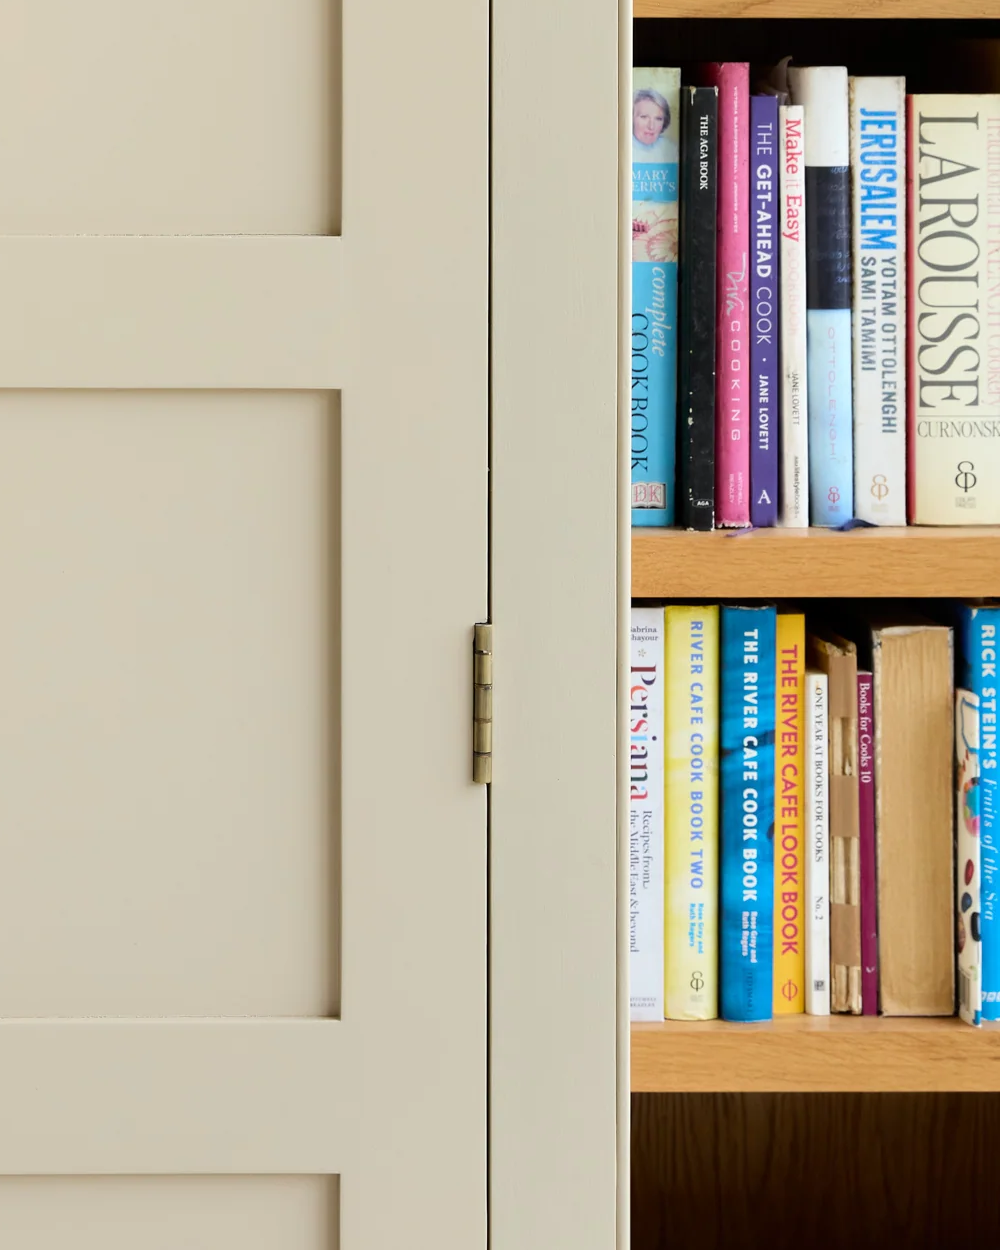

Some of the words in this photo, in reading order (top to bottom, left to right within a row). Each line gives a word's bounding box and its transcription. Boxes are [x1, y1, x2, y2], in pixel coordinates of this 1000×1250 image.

[700, 114, 708, 136] THE
[757, 122, 772, 156] THE
[785, 119, 802, 174] Make
[700, 138, 709, 160] AGA
[700, 161, 708, 190] BOOK
[860, 107, 898, 251] JERUSALEM
[756, 164, 772, 278] GET-AHEAD
[782, 195, 802, 243] Easy
[861, 256, 876, 300] SAMI
[917, 111, 980, 409] LAROUSSE
[881, 256, 897, 316] YOTAM
[645, 266, 672, 357] complete
[756, 286, 772, 344] COOK
[861, 307, 876, 371] TAMIMI
[632, 313, 649, 472] COOKBOOK
[731, 320, 741, 441] COOKING
[759, 375, 769, 403] JANE
[828, 327, 837, 460] OTTOLENGHI
[881, 322, 897, 434] OTTOLENGHI
[759, 407, 769, 450] LOVETT
[792, 394, 800, 425] LOVETT
[634, 484, 662, 503] DK
[690, 621, 704, 675] RIVER
[743, 628, 759, 664] THE
[781, 644, 798, 688] THE
[981, 624, 996, 677] RICK
[690, 682, 704, 725] CAFE
[743, 672, 759, 729] RIVER
[815, 687, 824, 710] ONE
[859, 682, 870, 714] Books
[631, 664, 657, 802] Persiana
[781, 694, 798, 758] RIVER
[815, 713, 824, 741] YEAR
[860, 716, 871, 731] for
[982, 687, 996, 769] STEIN'S
[690, 732, 704, 783] COOK
[742, 735, 758, 782] CAFE
[815, 744, 824, 757] AT
[860, 733, 872, 768] Cooks
[781, 763, 798, 818] CAFE
[815, 760, 824, 797] BOOKS
[861, 770, 871, 783] 10
[630, 810, 639, 828] the
[690, 791, 704, 842] BOOK
[742, 788, 758, 842] COOK
[815, 801, 823, 821] FOR
[983, 778, 998, 828] Fruits
[630, 831, 639, 870] Middle
[640, 810, 653, 854] Recipes
[815, 823, 823, 863] COOKS
[980, 834, 997, 854] of
[642, 855, 653, 889] from
[690, 848, 704, 889] TWO
[742, 848, 758, 902] BOOK
[781, 824, 798, 885] LOOK
[984, 856, 999, 884] the
[630, 873, 639, 895] East
[815, 896, 823, 912] No.
[984, 890, 994, 921] Sea
[749, 931, 758, 948] Gray
[750, 911, 758, 929] Rose
[781, 892, 798, 955] BOOK
[741, 931, 749, 956] Rogers
[750, 949, 758, 963] and
